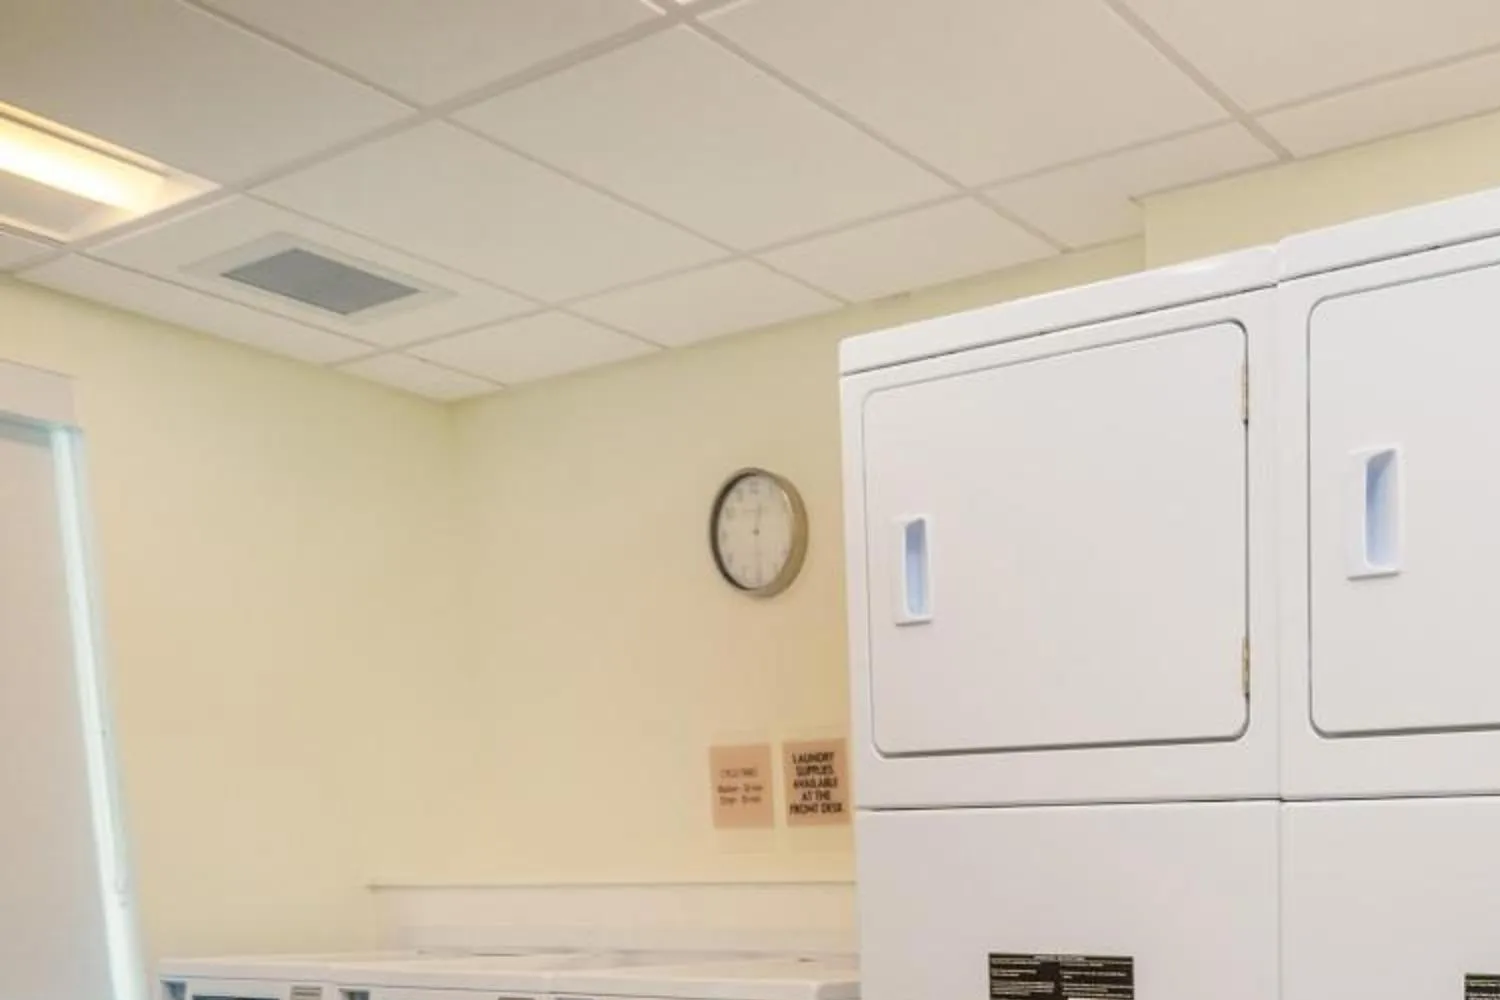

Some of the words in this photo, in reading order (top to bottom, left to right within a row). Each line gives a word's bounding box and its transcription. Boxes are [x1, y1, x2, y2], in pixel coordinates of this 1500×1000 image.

[792, 752, 835, 764] LAUNDRY
[795, 765, 834, 776] SUPPLIES
[793, 777, 838, 789] AVAILABLE
[801, 790, 813, 801] AT
[815, 789, 831, 801] THE
[789, 803, 818, 815] FRONT
[821, 802, 843, 814] DESK
